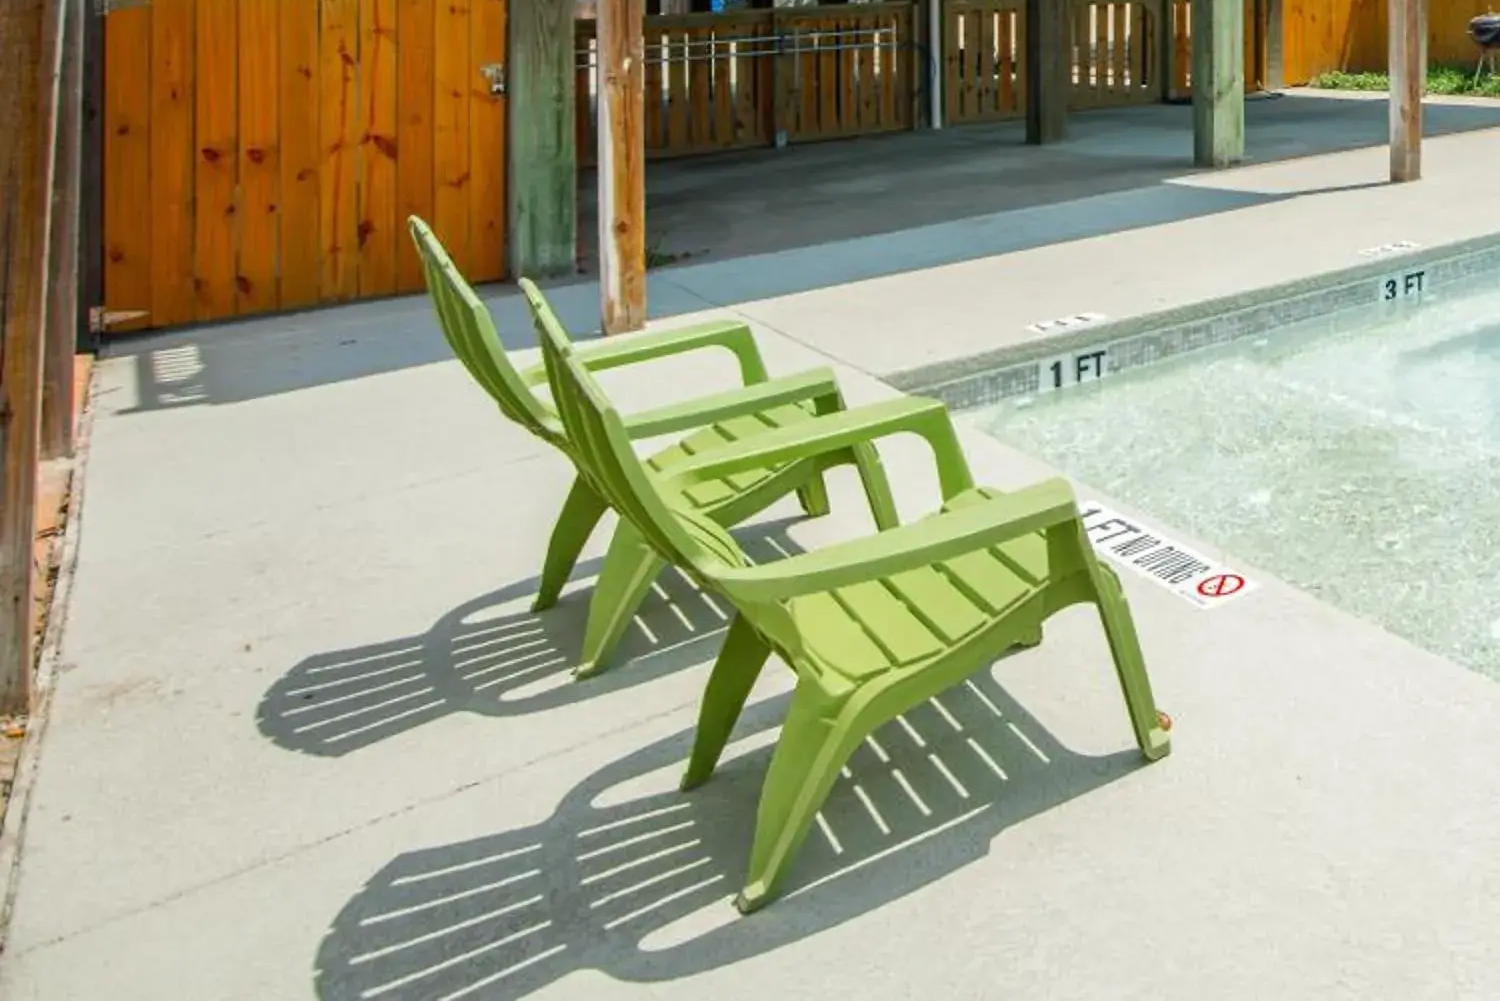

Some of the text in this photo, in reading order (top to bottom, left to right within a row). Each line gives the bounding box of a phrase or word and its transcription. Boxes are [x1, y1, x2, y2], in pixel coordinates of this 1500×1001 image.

[1385, 270, 1425, 300] 3 FT
[1049, 350, 1106, 388] 1 FT
[1086, 518, 1142, 544] FT
[1110, 533, 1161, 557] NO
